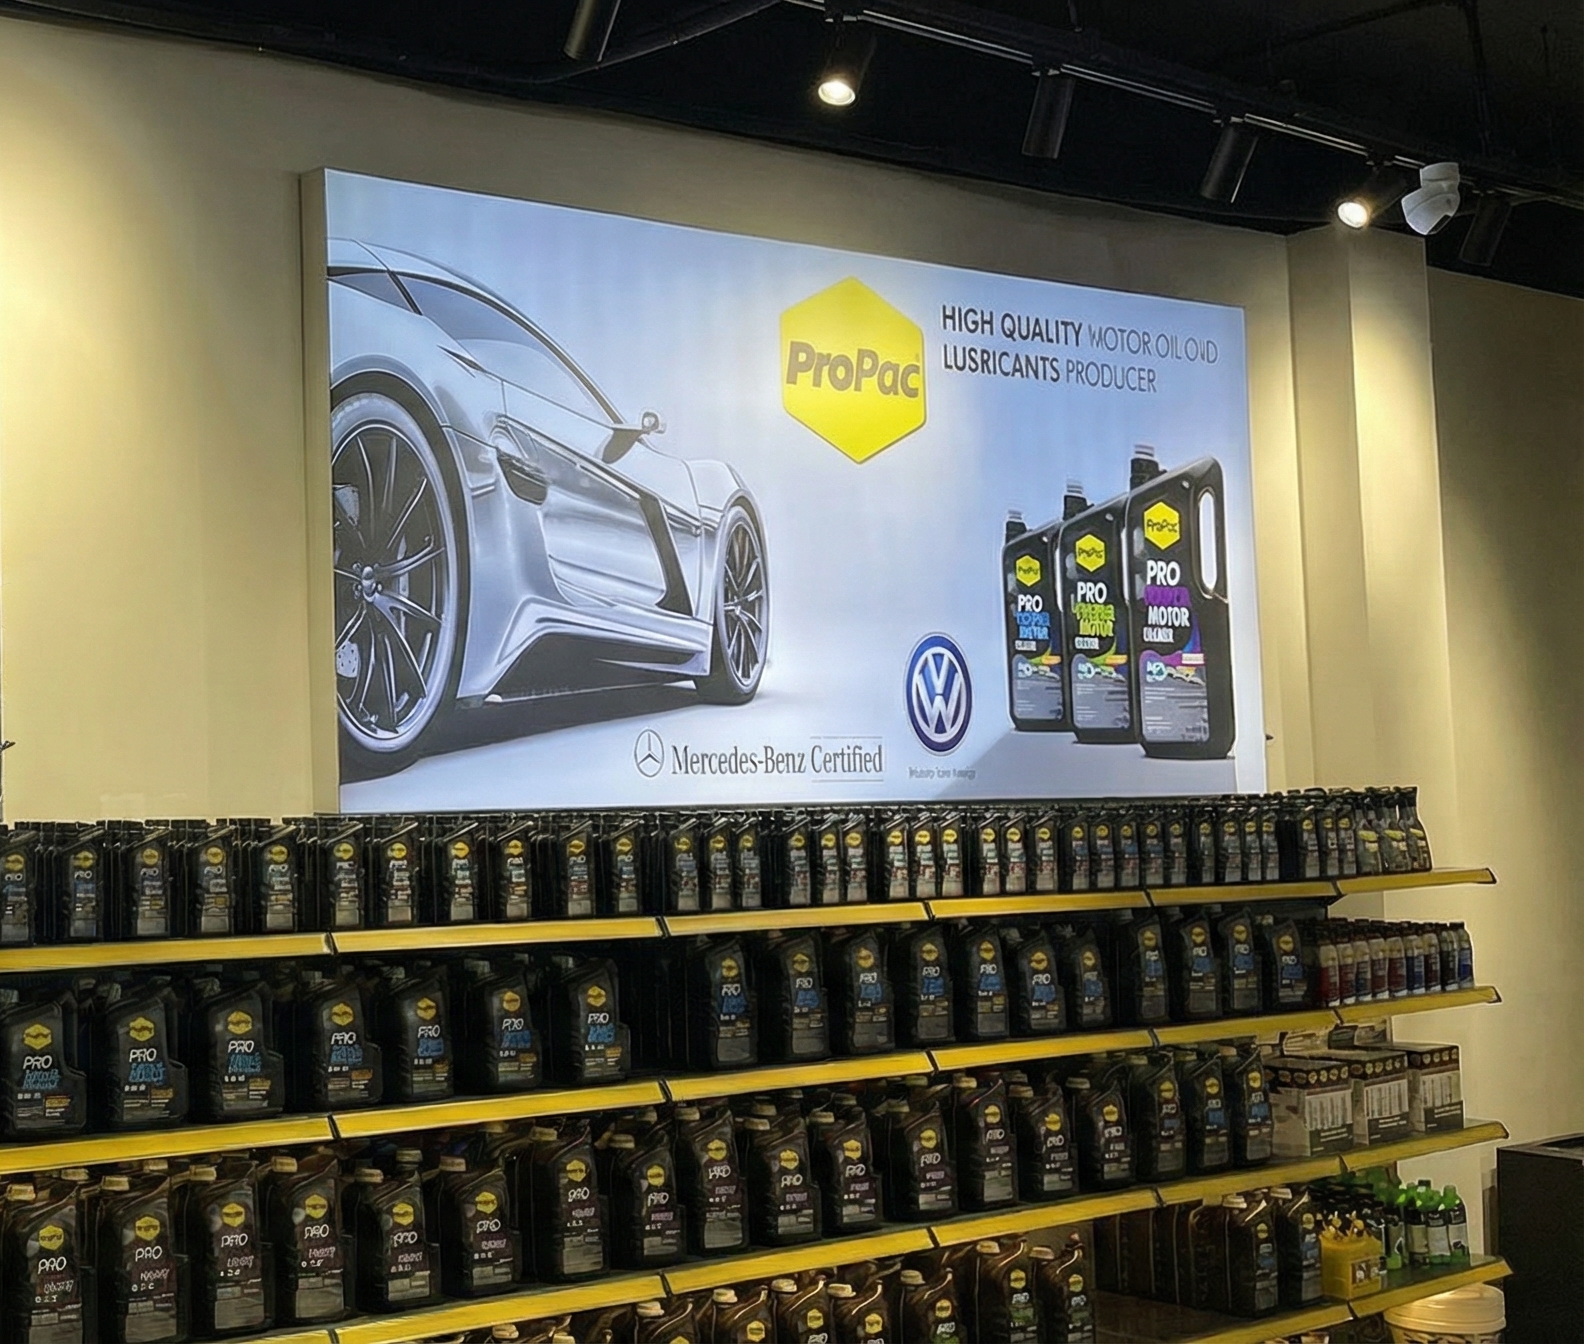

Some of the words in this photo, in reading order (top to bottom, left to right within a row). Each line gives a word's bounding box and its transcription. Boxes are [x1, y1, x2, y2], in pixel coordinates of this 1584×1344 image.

[942, 304, 994, 336] HIGH
[1000, 312, 1083, 347] QUALITY
[1155, 333, 1182, 360] OIL
[786, 340, 920, 399] ProPac
[943, 343, 1061, 383] LUSRICANTS
[1066, 358, 1157, 393] PRODUCER
[1146, 561, 1181, 586] PRO
[1017, 594, 1043, 612] PRO
[1077, 582, 1107, 603] PRO
[671, 744, 806, 775] Mercedes-Benz
[811, 744, 883, 773] Certified
[23, 1055, 53, 1070] PRO
[38, 1256, 67, 1274] PRO
